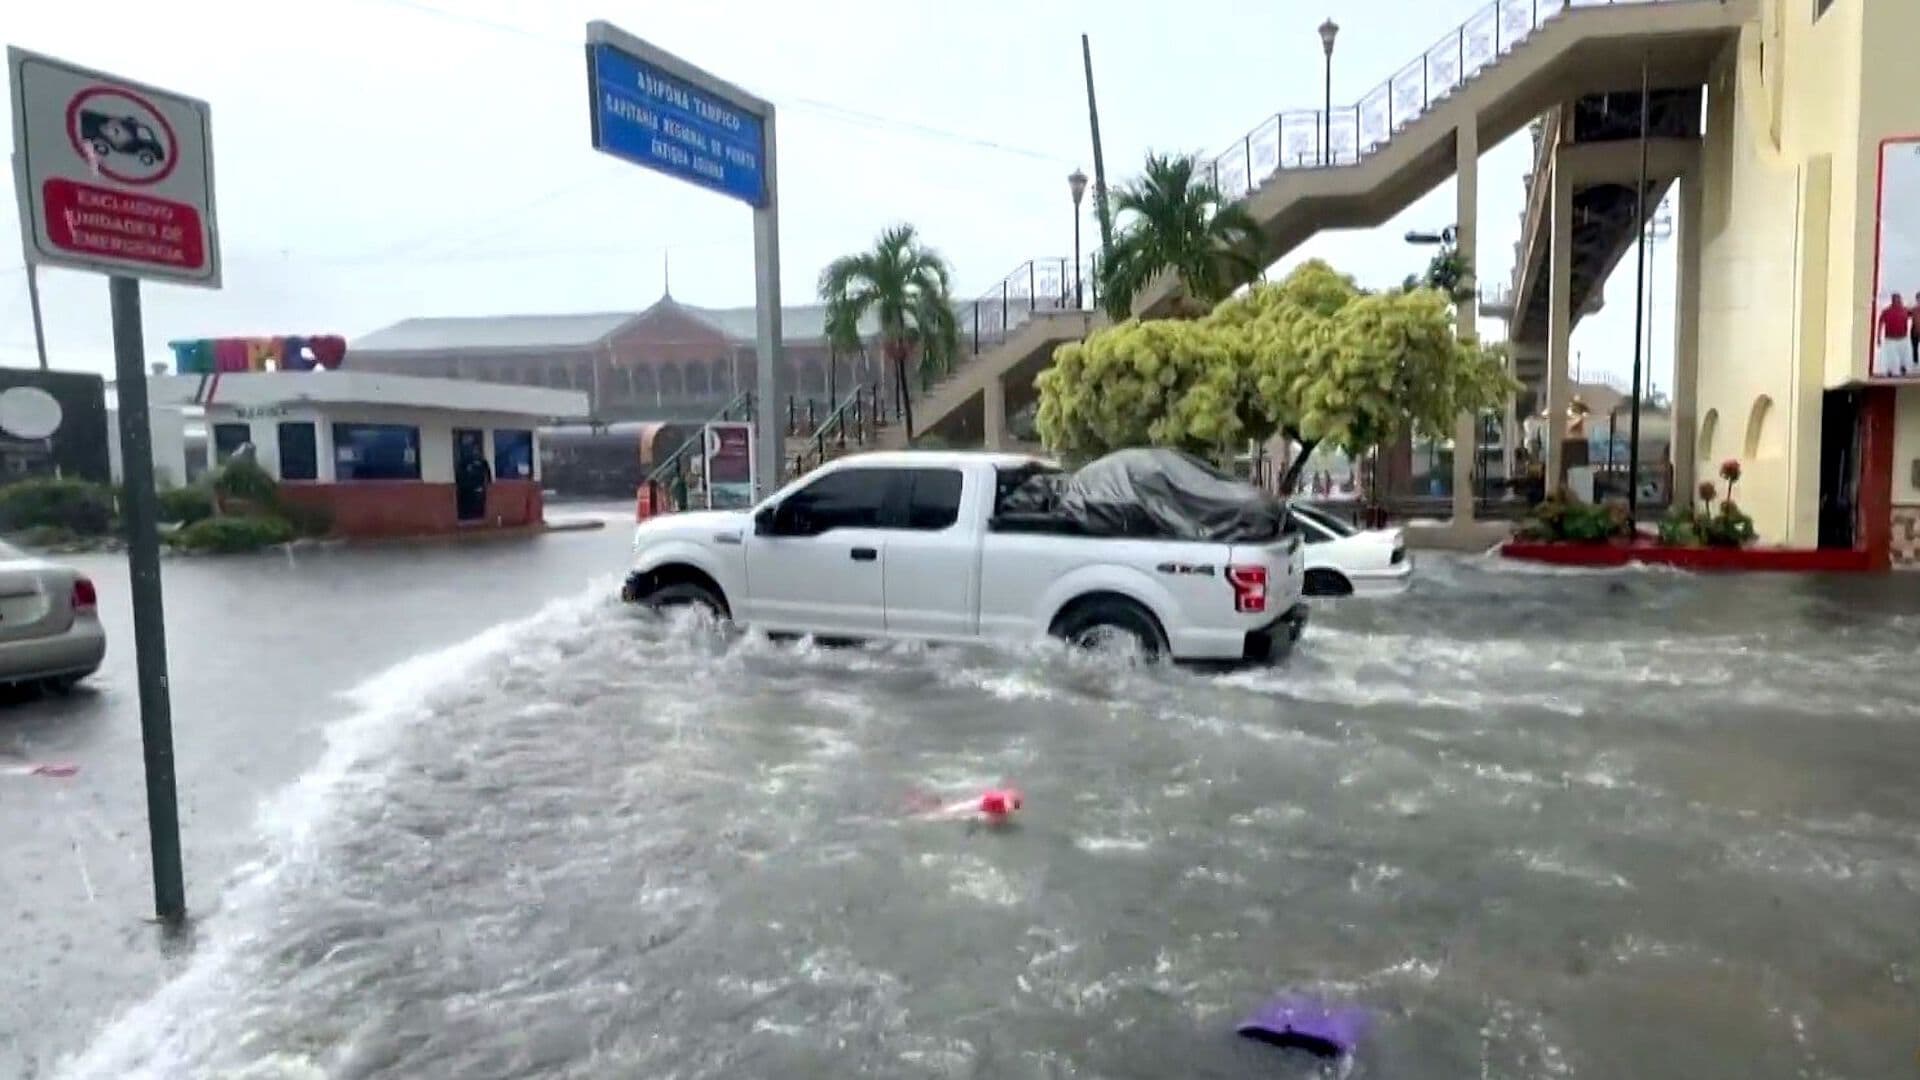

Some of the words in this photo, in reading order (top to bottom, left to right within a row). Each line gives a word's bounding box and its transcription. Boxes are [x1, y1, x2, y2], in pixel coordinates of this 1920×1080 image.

[694, 97, 741, 131] TAMPICO
[77, 190, 174, 220] EXCLUSIVO
[71, 210, 157, 237] UNIDADES
[161, 224, 184, 242] DE
[72, 229, 186, 261] EMERGENCIA
